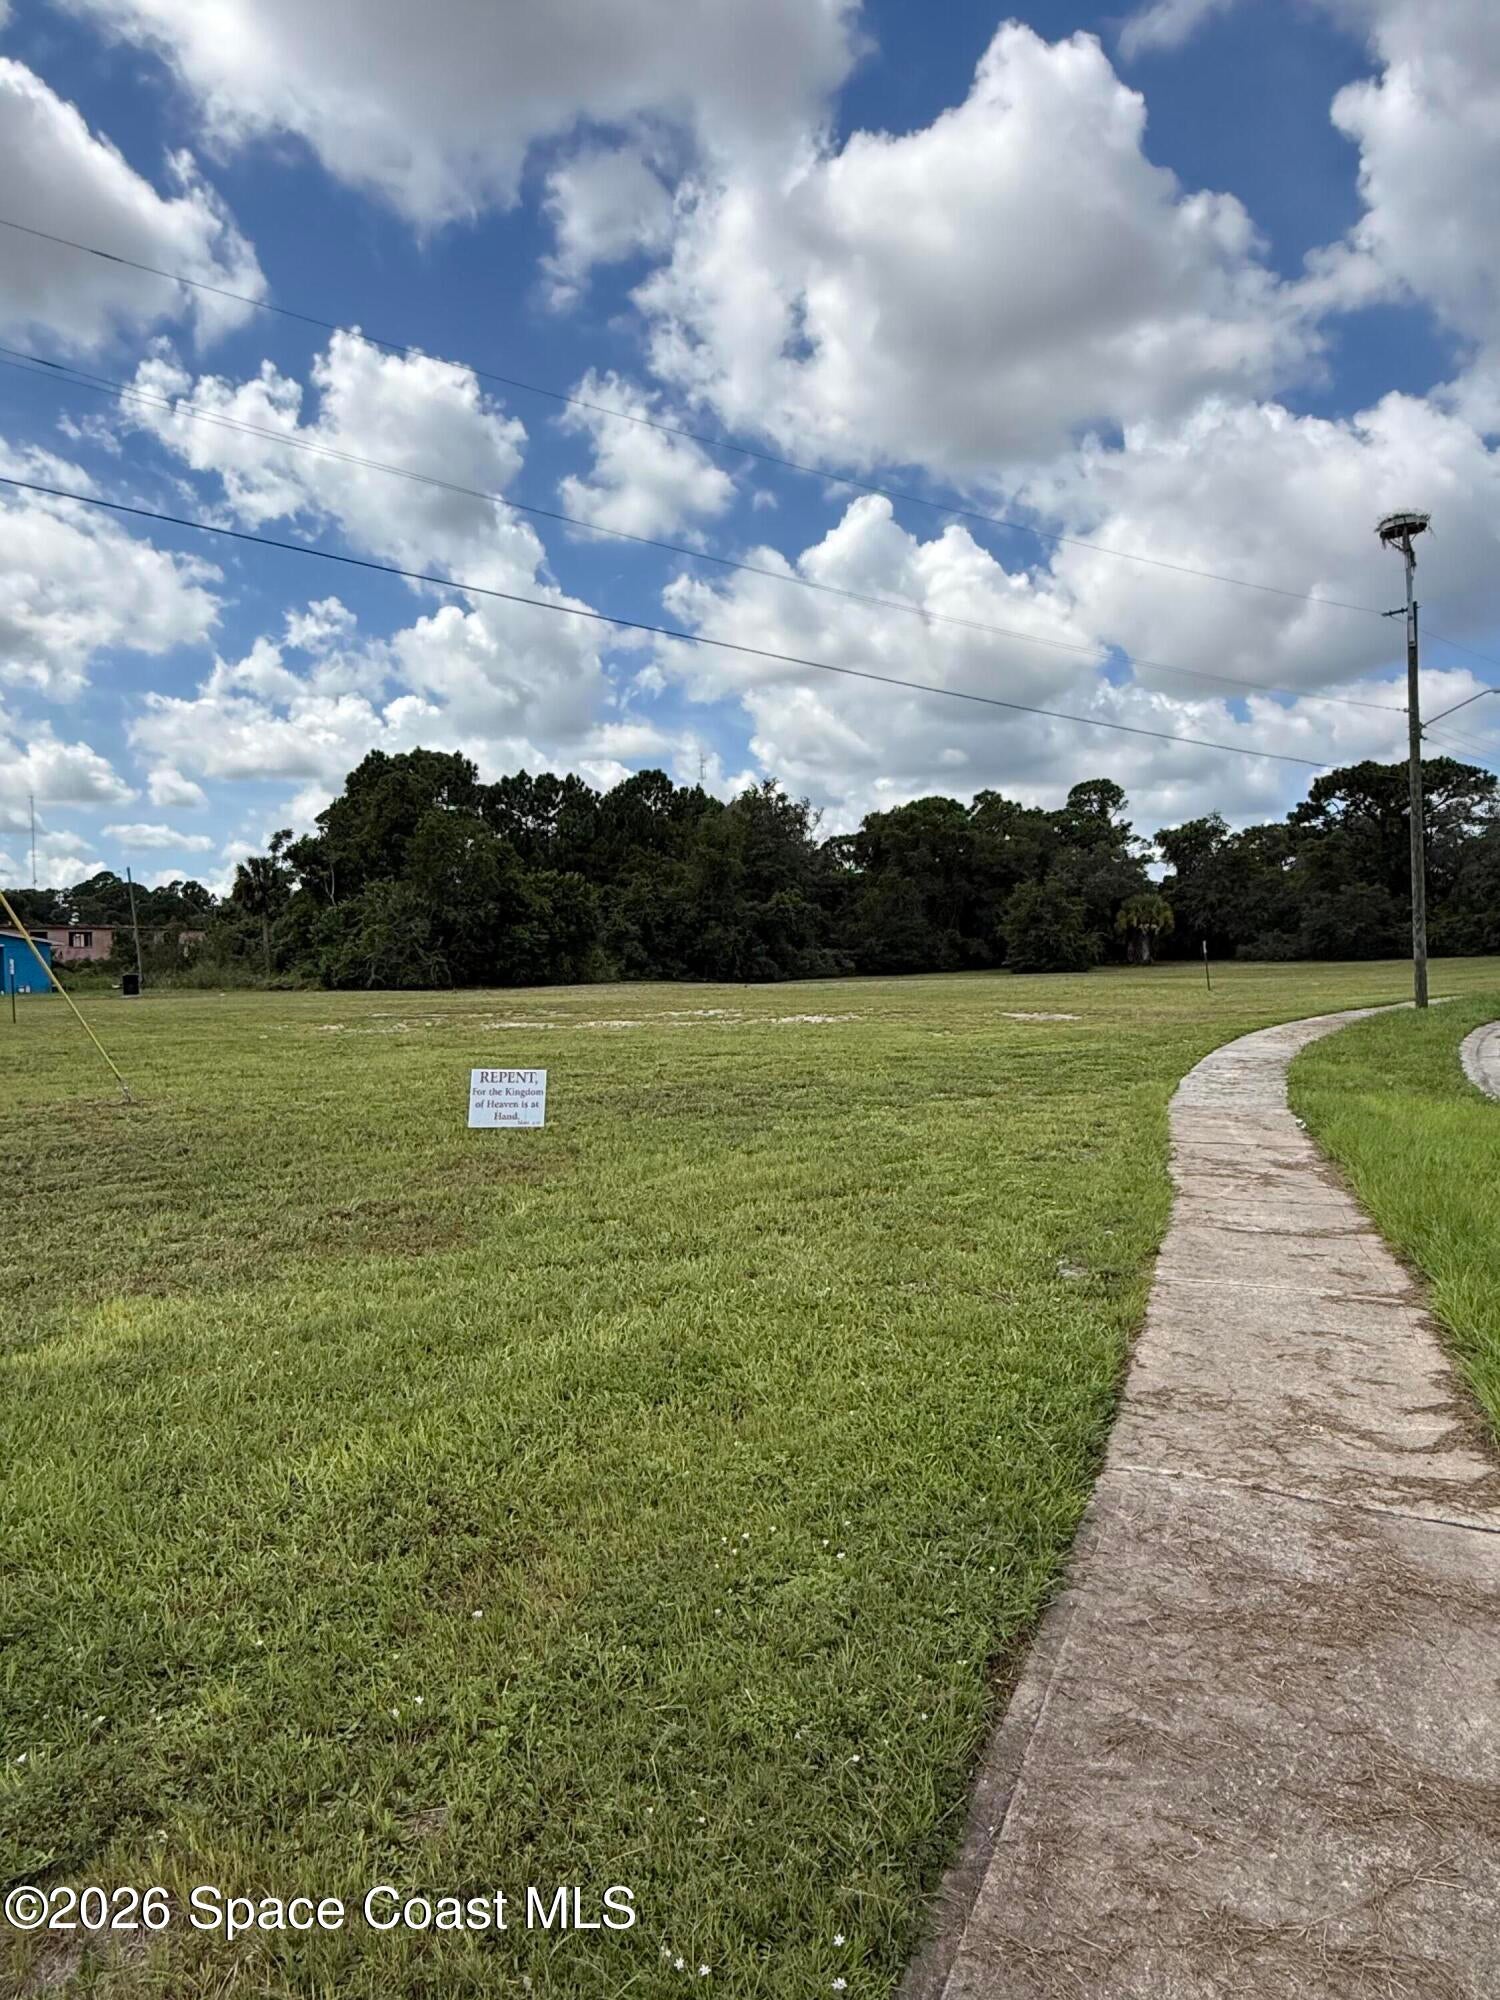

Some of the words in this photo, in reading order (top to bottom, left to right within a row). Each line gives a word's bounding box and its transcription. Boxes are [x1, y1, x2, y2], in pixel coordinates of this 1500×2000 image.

[480, 1071, 538, 1085] REPENT,
[472, 1087, 486, 1096] For
[489, 1087, 502, 1096] the
[505, 1087, 544, 1099] Kingdom
[475, 1100, 485, 1109] of
[487, 1100, 519, 1109] Heaven
[521, 1100, 528, 1109] is
[530, 1101, 539, 1109] at
[494, 1111, 520, 1121] Hand.
